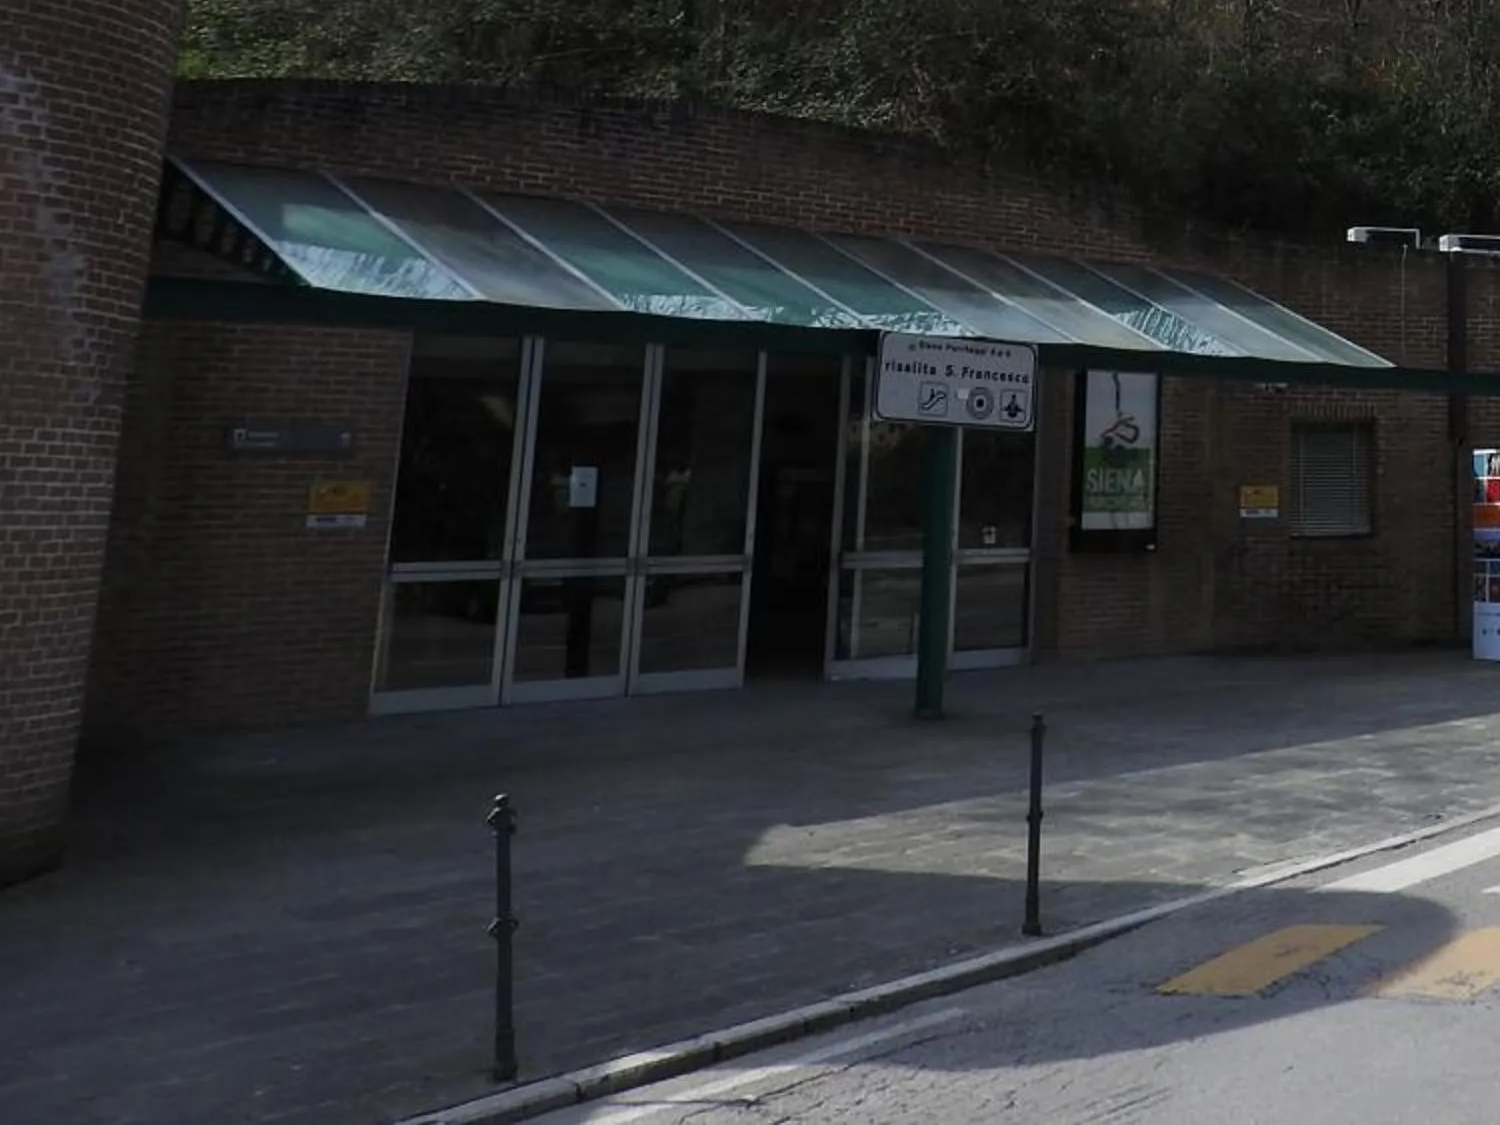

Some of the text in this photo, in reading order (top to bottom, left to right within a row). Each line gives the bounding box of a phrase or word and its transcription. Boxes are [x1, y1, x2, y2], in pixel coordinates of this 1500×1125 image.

[885, 359, 937, 375] risalita
[961, 366, 1030, 383] Francesco
[1086, 468, 1146, 494] SIENA
